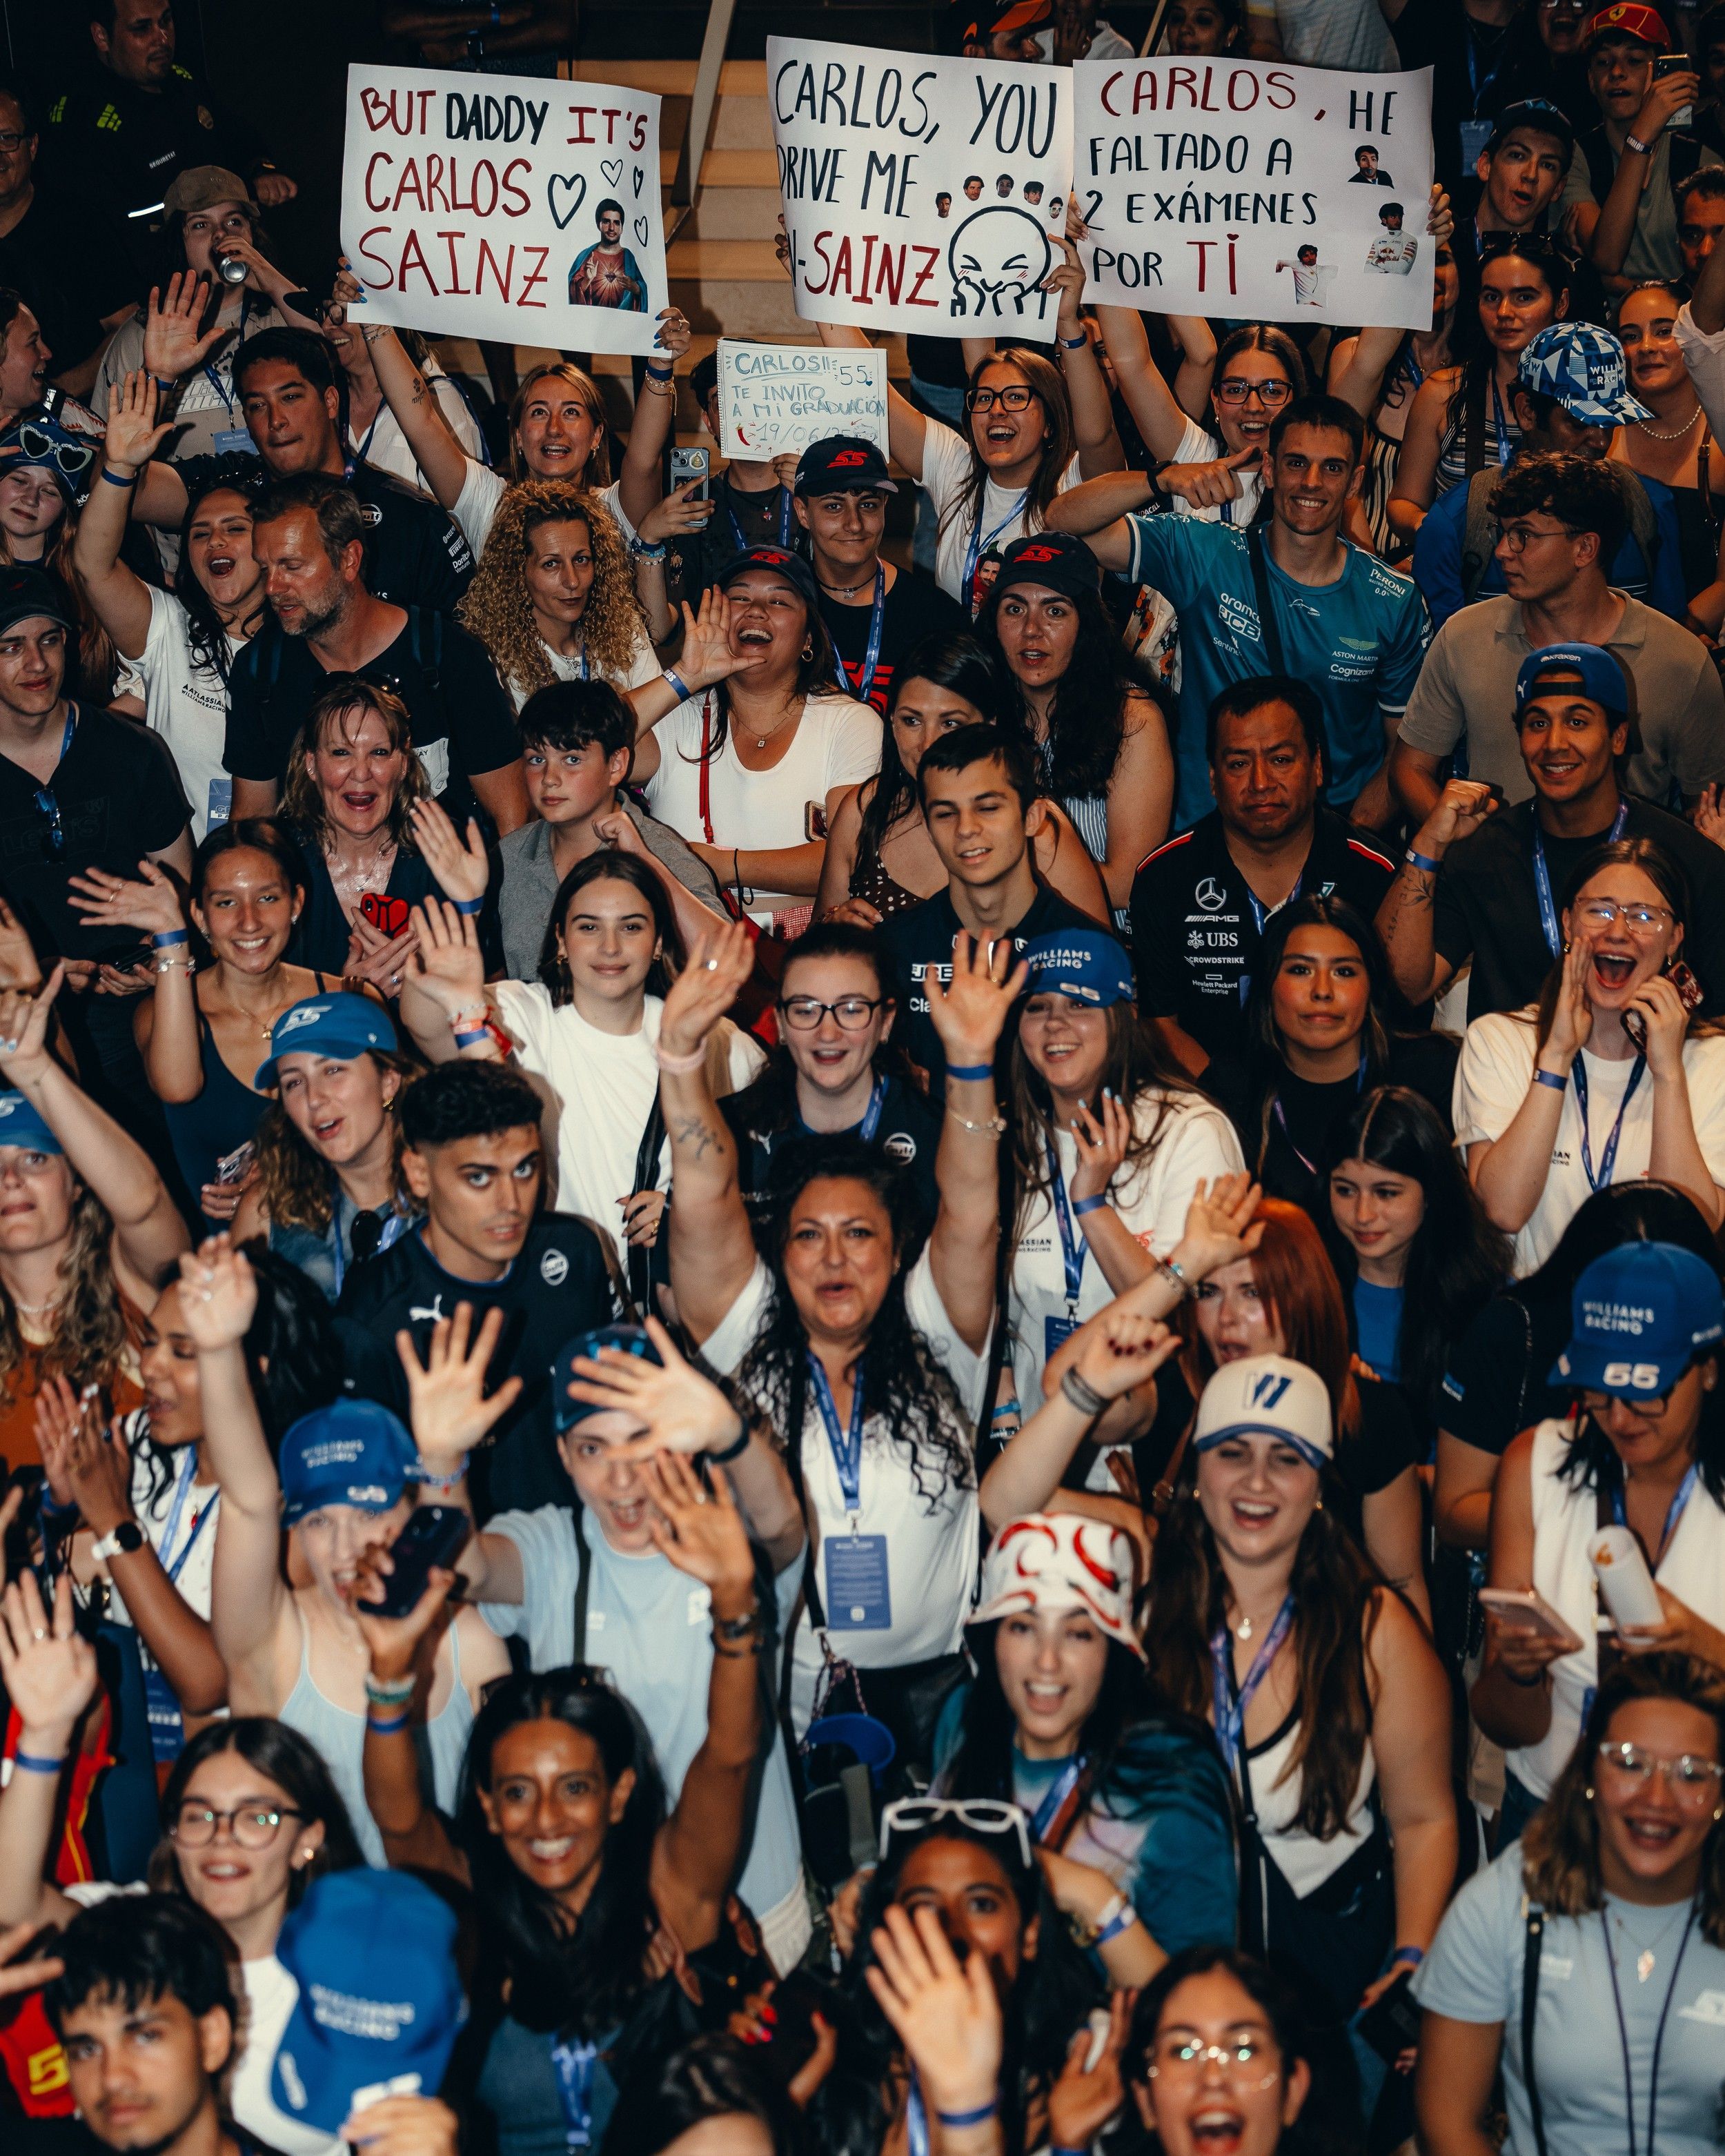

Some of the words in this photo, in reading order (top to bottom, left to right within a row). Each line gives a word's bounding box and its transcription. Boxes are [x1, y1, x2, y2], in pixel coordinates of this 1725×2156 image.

[359, 87, 436, 136] BUT
[446, 92, 549, 146] DADDY
[566, 106, 648, 152] IT'S
[776, 59, 940, 144] CARLOS,
[969, 75, 1056, 159] YOU
[1348, 90, 1398, 135] HE
[1090, 132, 1249, 176] FALTADO
[1265, 138, 1292, 176] A
[364, 152, 533, 217] CARLOS
[860, 150, 919, 218] ME
[1085, 190, 1105, 231] 2
[1127, 181, 1318, 226] EXÁMENES
[358, 226, 549, 308] SAINZ
[787, 229, 940, 308] N-SAINZ
[1093, 247, 1163, 288] POR
[735, 353, 831, 375] CARLOS!!
[839, 365, 868, 386] 55
[731, 385, 751, 399] TE
[762, 383, 826, 401] INVITO
[732, 404, 742, 417] A
[827, 451, 868, 468] 55
[1013, 545, 1063, 563] 55
[1368, 578, 1383, 589] NASTRO
[1383, 586, 1401, 599] AZZURRO
[1370, 568, 1406, 595] PERONI
[1219, 604, 1261, 642] JCB
[1332, 651, 1355, 660] ASTON
[1549, 653, 1581, 662] kraken
[1330, 664, 1374, 677] Cognizant
[181, 689, 205, 706] WILLIAMS
[206, 703, 226, 713] RACING
[1207, 932, 1239, 947] UBS
[1027, 949, 1092, 965] WILLIAMS
[1188, 956, 1245, 965] CROWDSTRIKE
[1192, 980, 1214, 988] Hewlett
